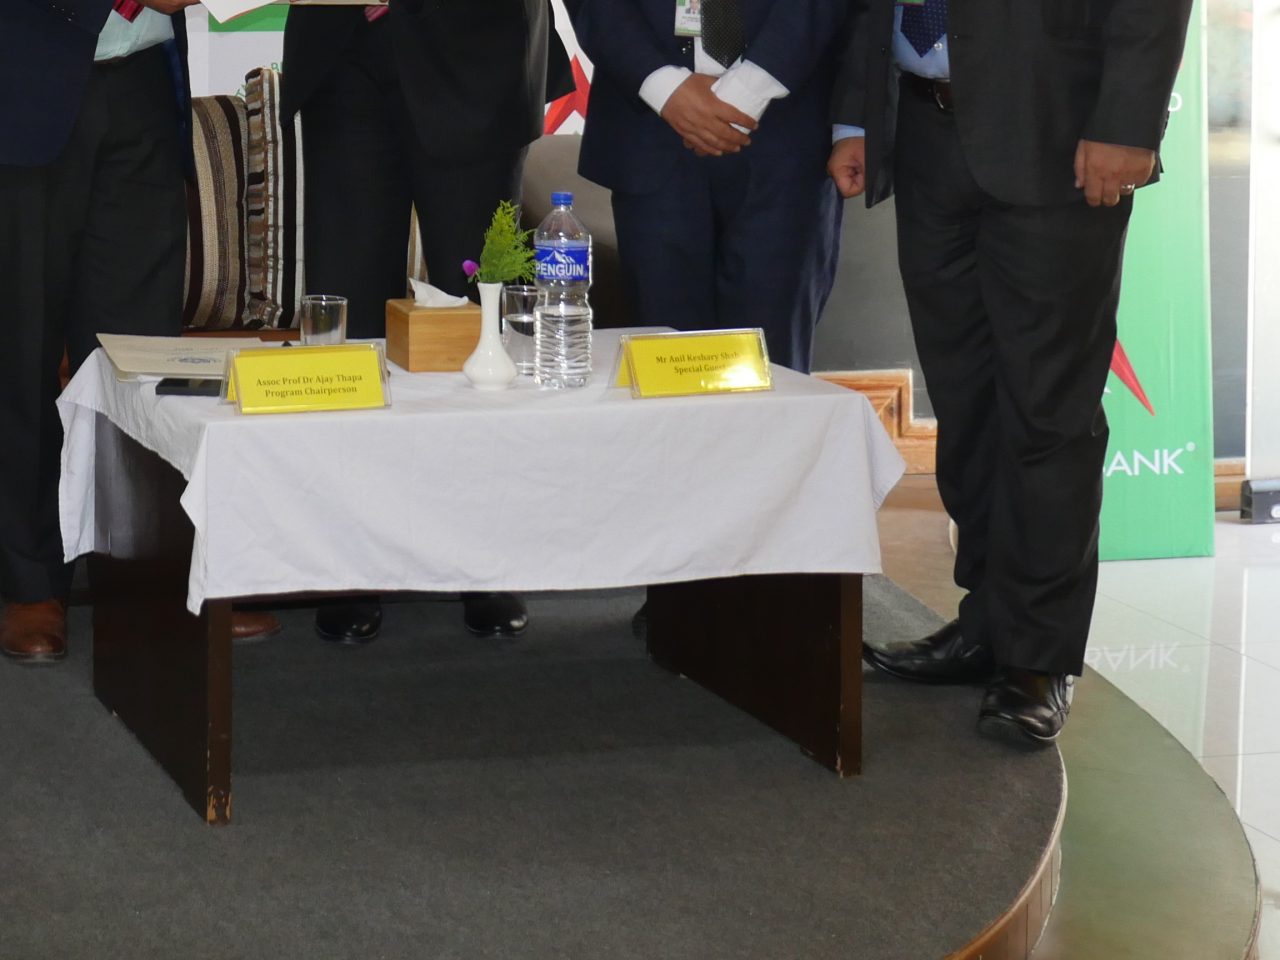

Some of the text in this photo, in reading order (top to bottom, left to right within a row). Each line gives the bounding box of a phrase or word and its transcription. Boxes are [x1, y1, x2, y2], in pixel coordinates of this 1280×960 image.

[535, 262, 584, 276] PENGUIN
[656, 355, 667, 364] Mr
[669, 353, 686, 364] Anil
[674, 364, 703, 375] Special
[256, 374, 363, 387] Assoc Prof Dr Ajay Thapa
[265, 386, 358, 399] Program Chairperson
[1103, 447, 1185, 478] ANK
